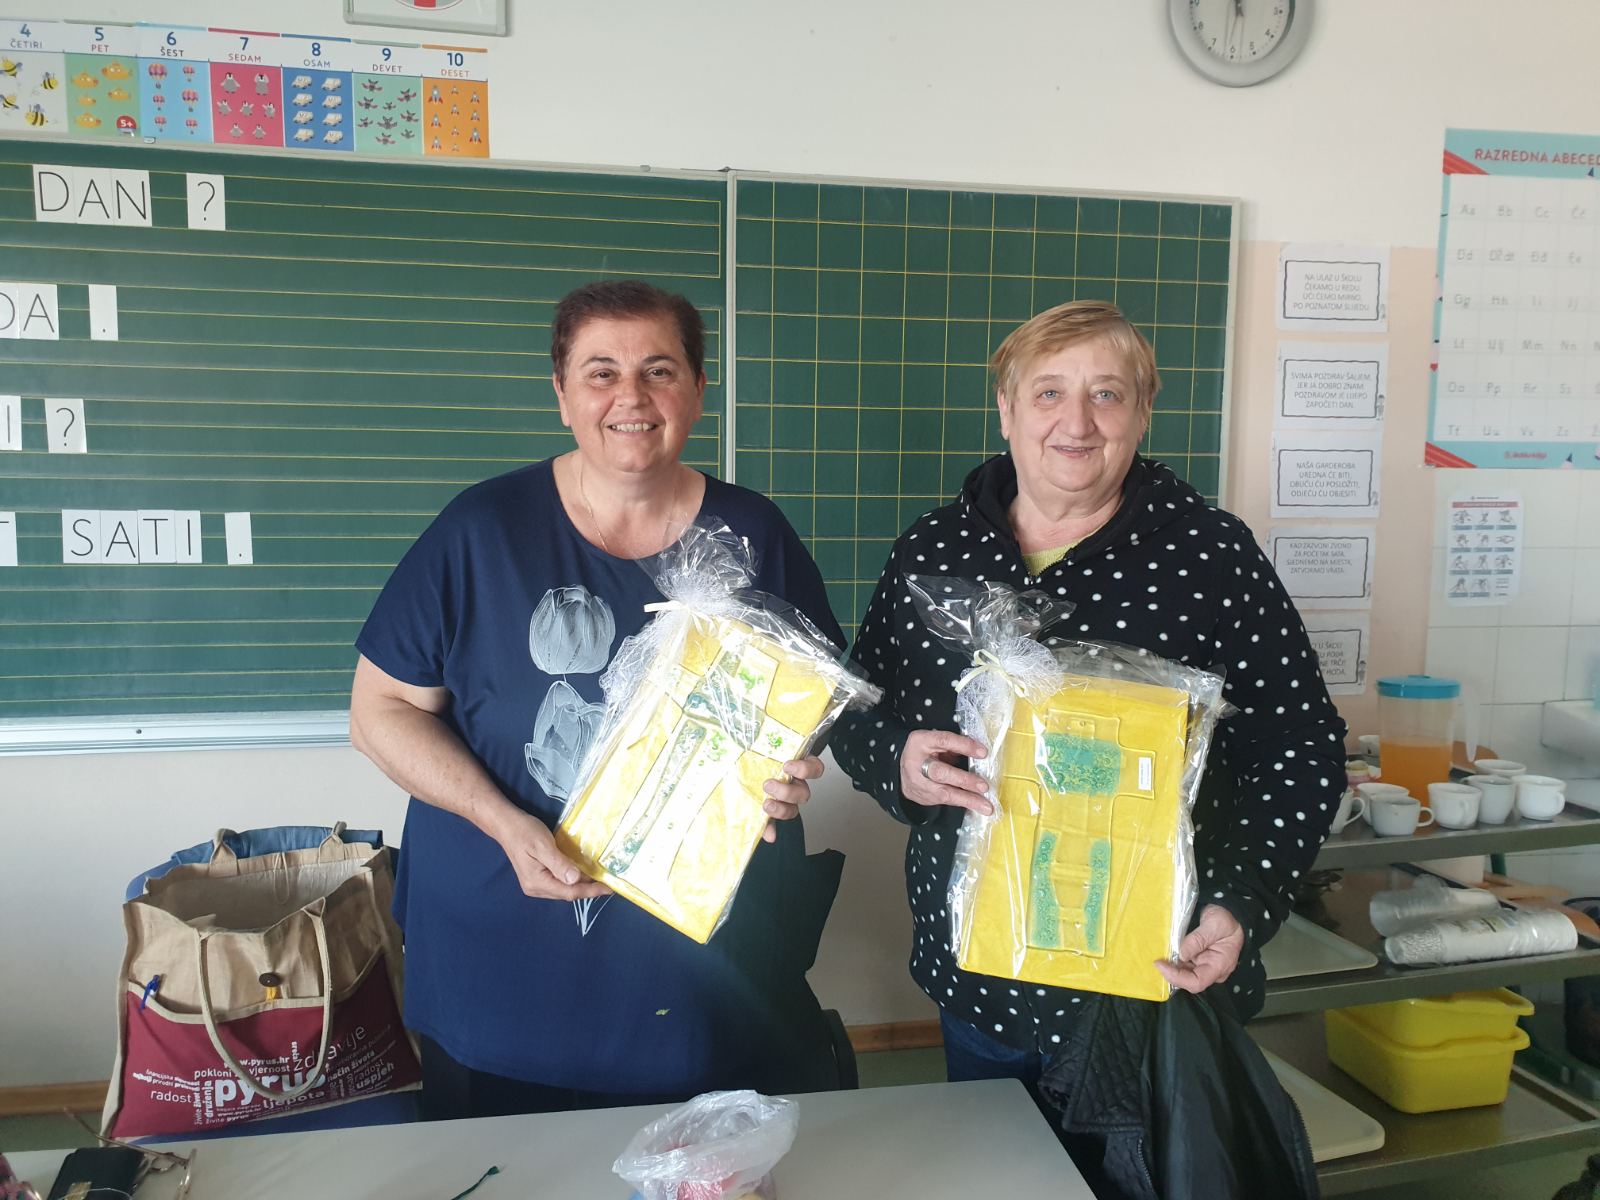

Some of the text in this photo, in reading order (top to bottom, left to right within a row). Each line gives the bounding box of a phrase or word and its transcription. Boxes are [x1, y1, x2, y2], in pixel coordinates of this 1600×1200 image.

[20, 23, 32, 37] 4
[94, 27, 104, 41] 5
[10, 38, 43, 49] ČETIRI
[166, 31, 177, 46] 6
[239, 36, 249, 51] 7
[91, 44, 109, 53] PET
[160, 46, 184, 57] ŠEST
[311, 42, 322, 56] 8
[382, 47, 392, 61] 9
[228, 53, 262, 62] SEDAM
[303, 59, 331, 68] OSAM
[446, 52, 464, 66] 10
[372, 64, 402, 73] DEVET
[440, 69, 469, 78] DESET
[120, 119, 134, 127] 5+
[1474, 148, 1549, 162] RAZREDNA
[38, 171, 216, 221] DAN ?
[1304, 273, 1314, 281] NA
[1293, 302, 1303, 310] PO
[1454, 293, 1471, 309] Gg
[56, 407, 75, 447] ?
[1296, 461, 1356, 470] NAŠA GARDEROBA
[71, 518, 191, 559] SATI
[194, 1065, 232, 1081] pokloni
[249, 1065, 290, 1082] vjernost
[354, 1058, 384, 1083] radost
[356, 1062, 394, 1090] uspjeh
[150, 1090, 192, 1104] radost
[202, 1080, 216, 1118] druženja
